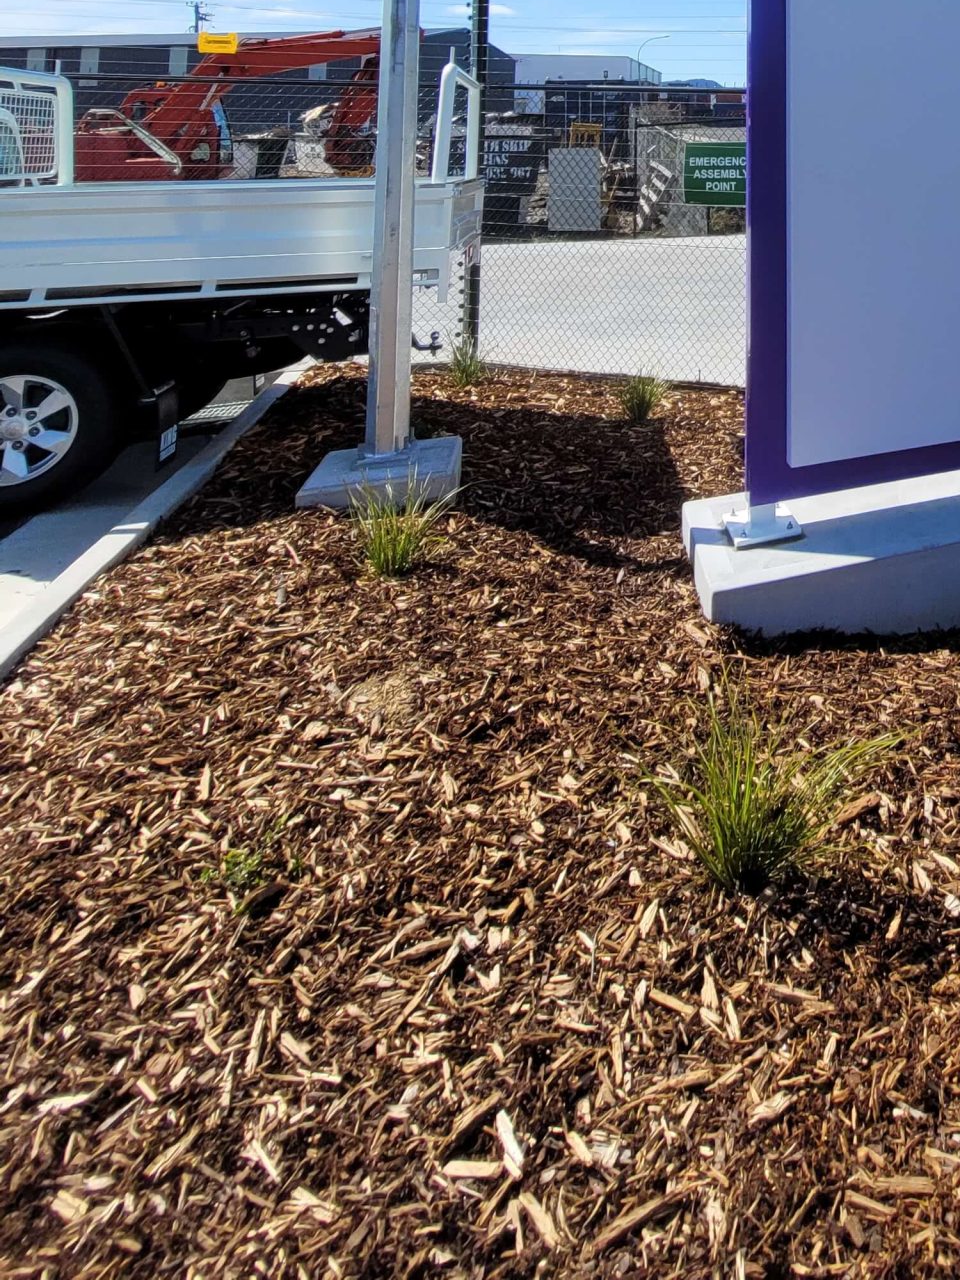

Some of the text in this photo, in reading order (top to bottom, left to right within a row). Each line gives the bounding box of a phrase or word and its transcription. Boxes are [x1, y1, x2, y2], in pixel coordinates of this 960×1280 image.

[689, 156, 748, 167] EMERGENC
[693, 169, 748, 179] ASSEMBLY
[705, 181, 737, 191] POINT
